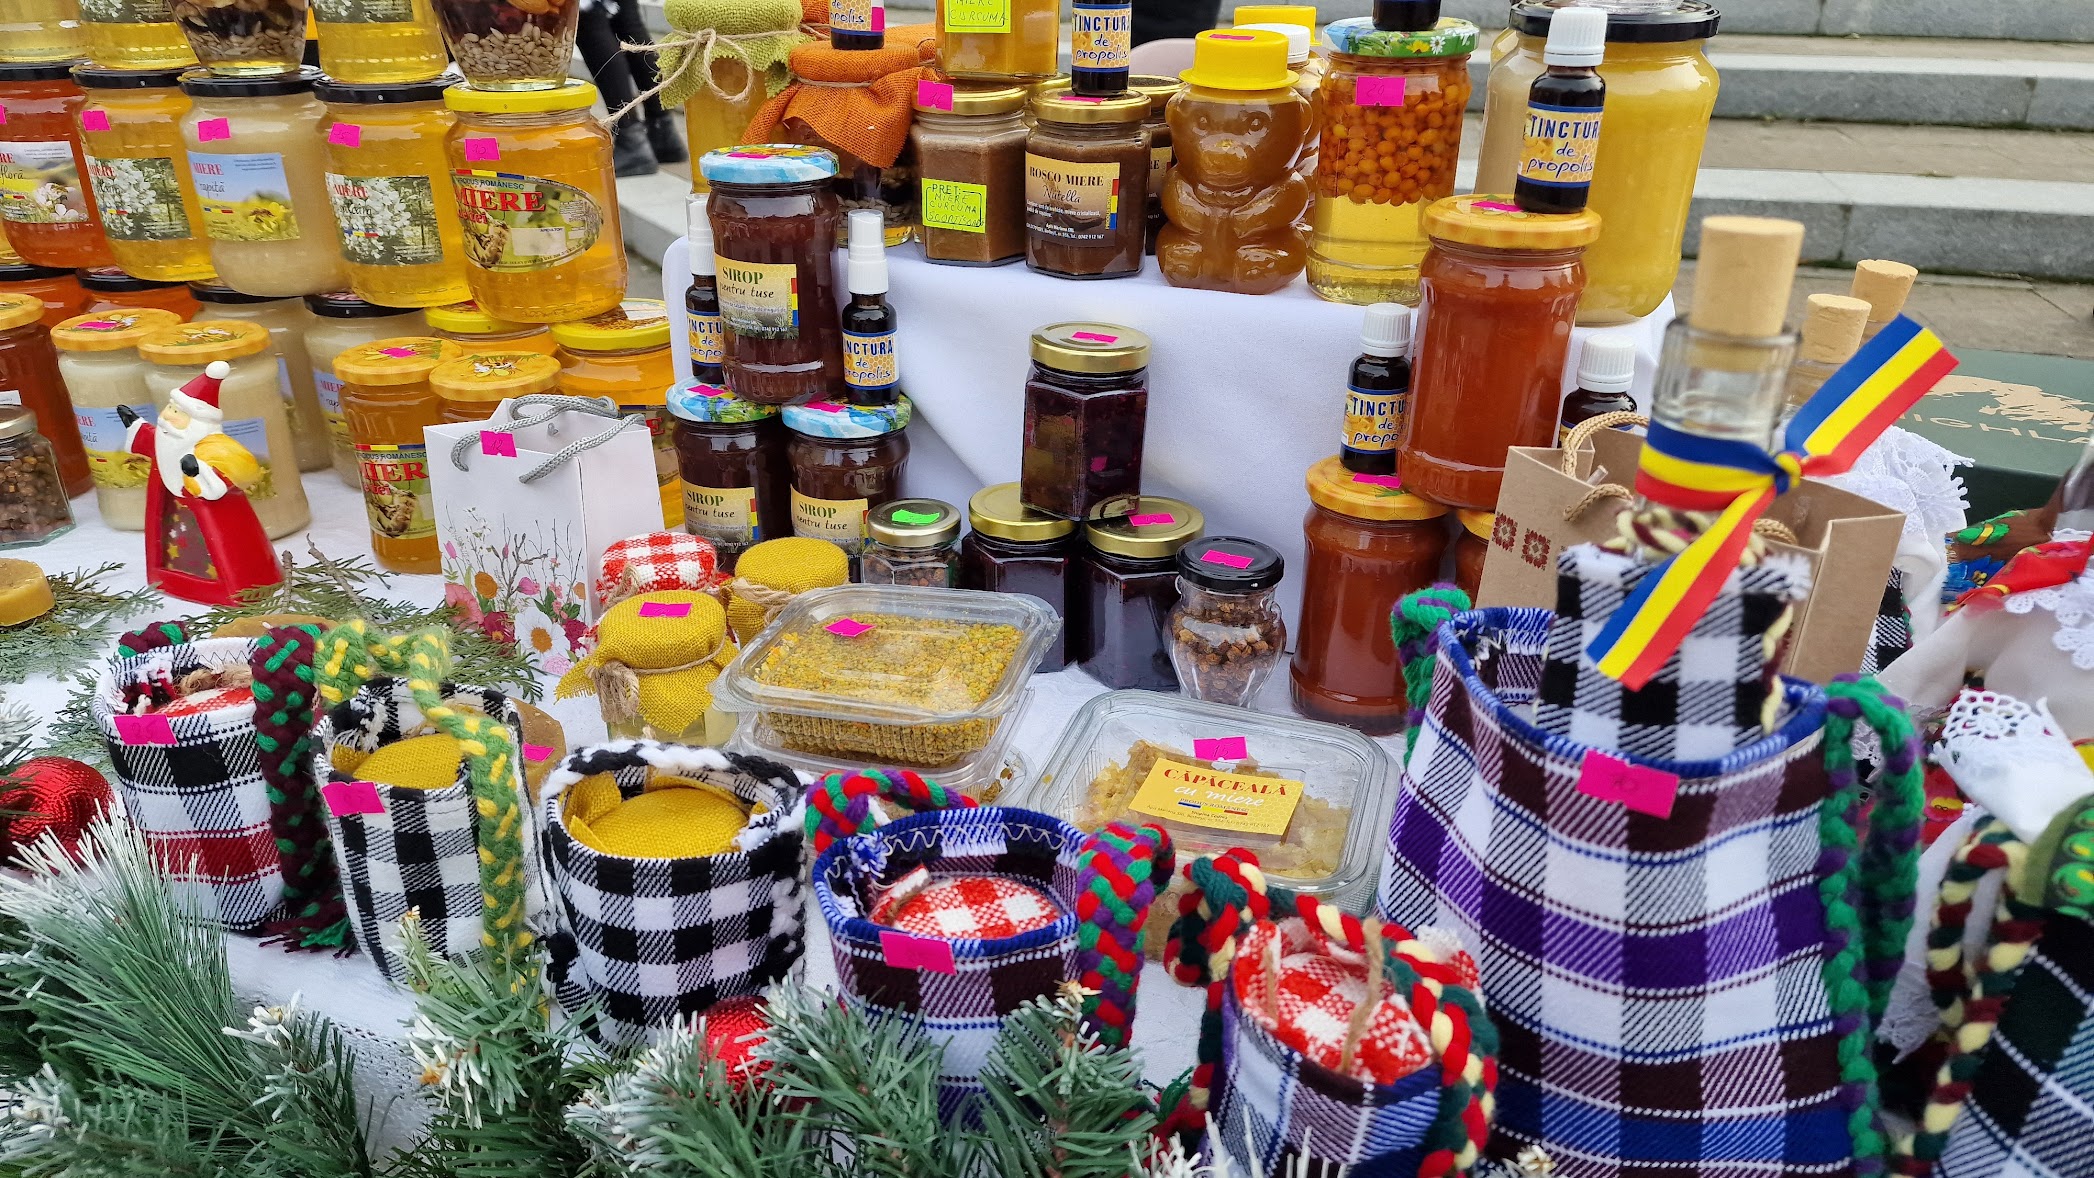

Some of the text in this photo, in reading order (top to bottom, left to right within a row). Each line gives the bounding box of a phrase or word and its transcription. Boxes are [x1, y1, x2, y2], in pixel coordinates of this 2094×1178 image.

[1094, 33, 1109, 46] de
[1076, 44, 1127, 65] propolis
[1556, 141, 1575, 157] de
[193, 162, 224, 175] MIERE
[1526, 154, 1593, 178] propolis
[1066, 174, 1104, 187] MIERE
[454, 185, 546, 212] MIERE
[1042, 184, 1081, 204] Nutella
[722, 266, 763, 285] SIROP
[750, 286, 775, 299] tuse
[701, 336, 713, 346] de
[856, 357, 868, 368] de
[1378, 418, 1393, 430] de
[687, 489, 724, 507] SIROP
[713, 507, 735, 518] tuse
[799, 501, 837, 519] SIROP
[825, 520, 847, 530] tuse
[1212, 743, 1234, 757] 15
[1164, 768, 1287, 796] CĂPĂCEALĂ
[1174, 786, 1265, 807] cu miere
